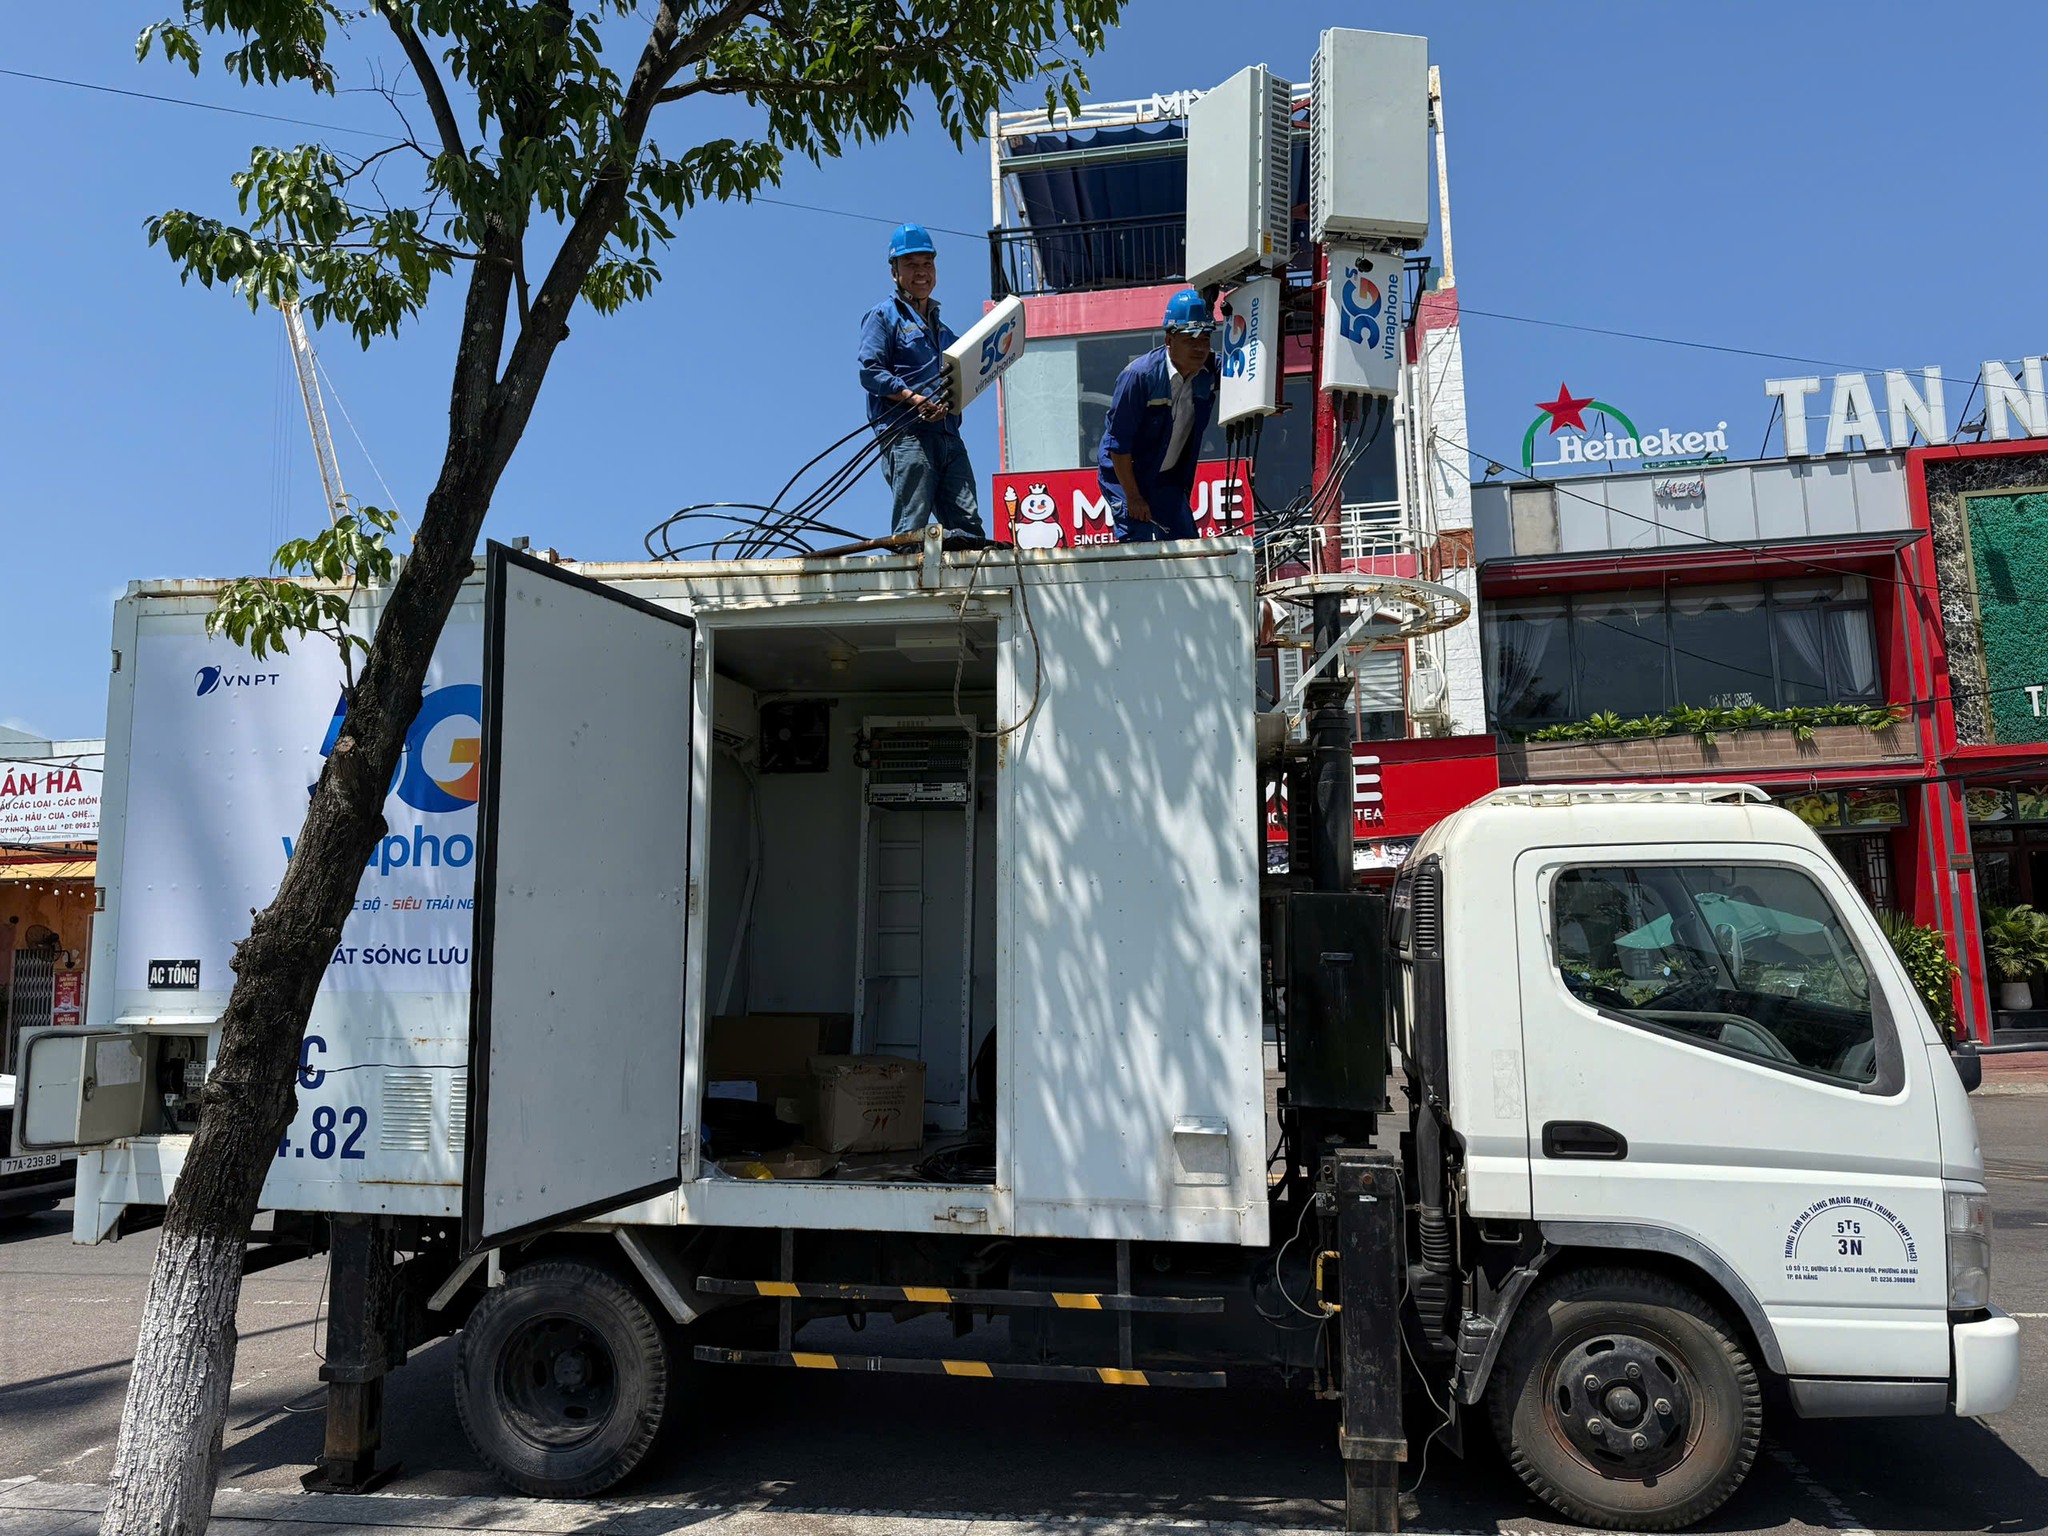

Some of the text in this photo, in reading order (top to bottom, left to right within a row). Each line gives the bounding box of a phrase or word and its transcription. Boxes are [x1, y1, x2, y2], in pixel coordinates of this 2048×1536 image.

[1152, 89, 1216, 119] MI
[1381, 273, 1399, 361] vinaphone
[1247, 296, 1260, 383] vinaphone
[1765, 364, 1950, 457] TAN
[1556, 427, 1729, 465] Heineken
[222, 673, 280, 687] VNPT
[57, 797, 76, 807] CÁC
[1354, 807, 1384, 820] TEA
[48, 812, 65, 820] CUA
[362, 896, 381, 913] ĐỘ
[392, 896, 422, 910] SIÊU
[426, 895, 454, 910] TRẢI
[362, 943, 421, 965] SÓNG
[427, 946, 469, 965] LƯU
[150, 960, 197, 984] AC TỔNG
[1785, 1234, 1796, 1259] TRUNG
[1828, 1195, 1852, 1207] MẠNG
[1874, 1203, 1898, 1223] TRUNG
